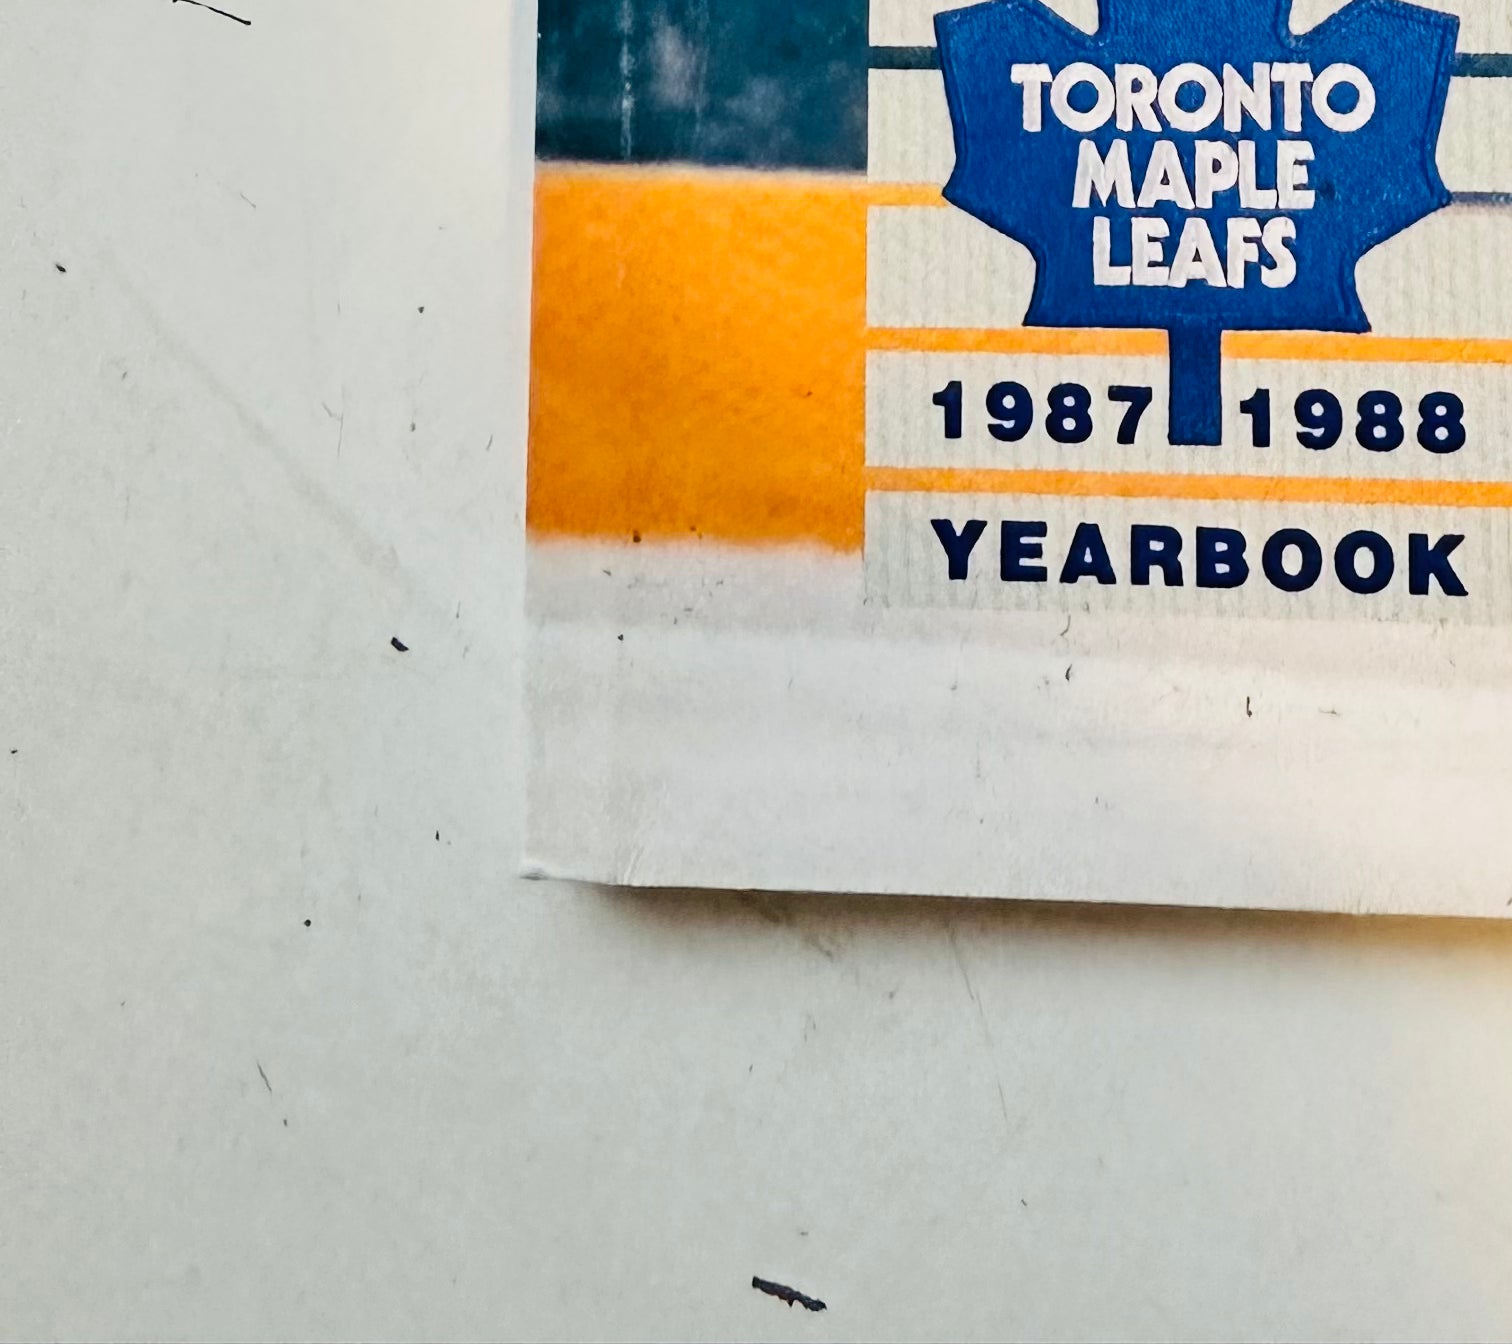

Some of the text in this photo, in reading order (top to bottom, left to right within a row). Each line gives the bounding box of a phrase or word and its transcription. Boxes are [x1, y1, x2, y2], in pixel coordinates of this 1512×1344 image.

[1010, 62, 1376, 133] TORONTO
[1072, 139, 1316, 210] MAPLE
[1093, 217, 1297, 290] LEAFS
[932, 380, 1467, 454] 1987 1988
[930, 518, 1469, 597] YEARBOOK
